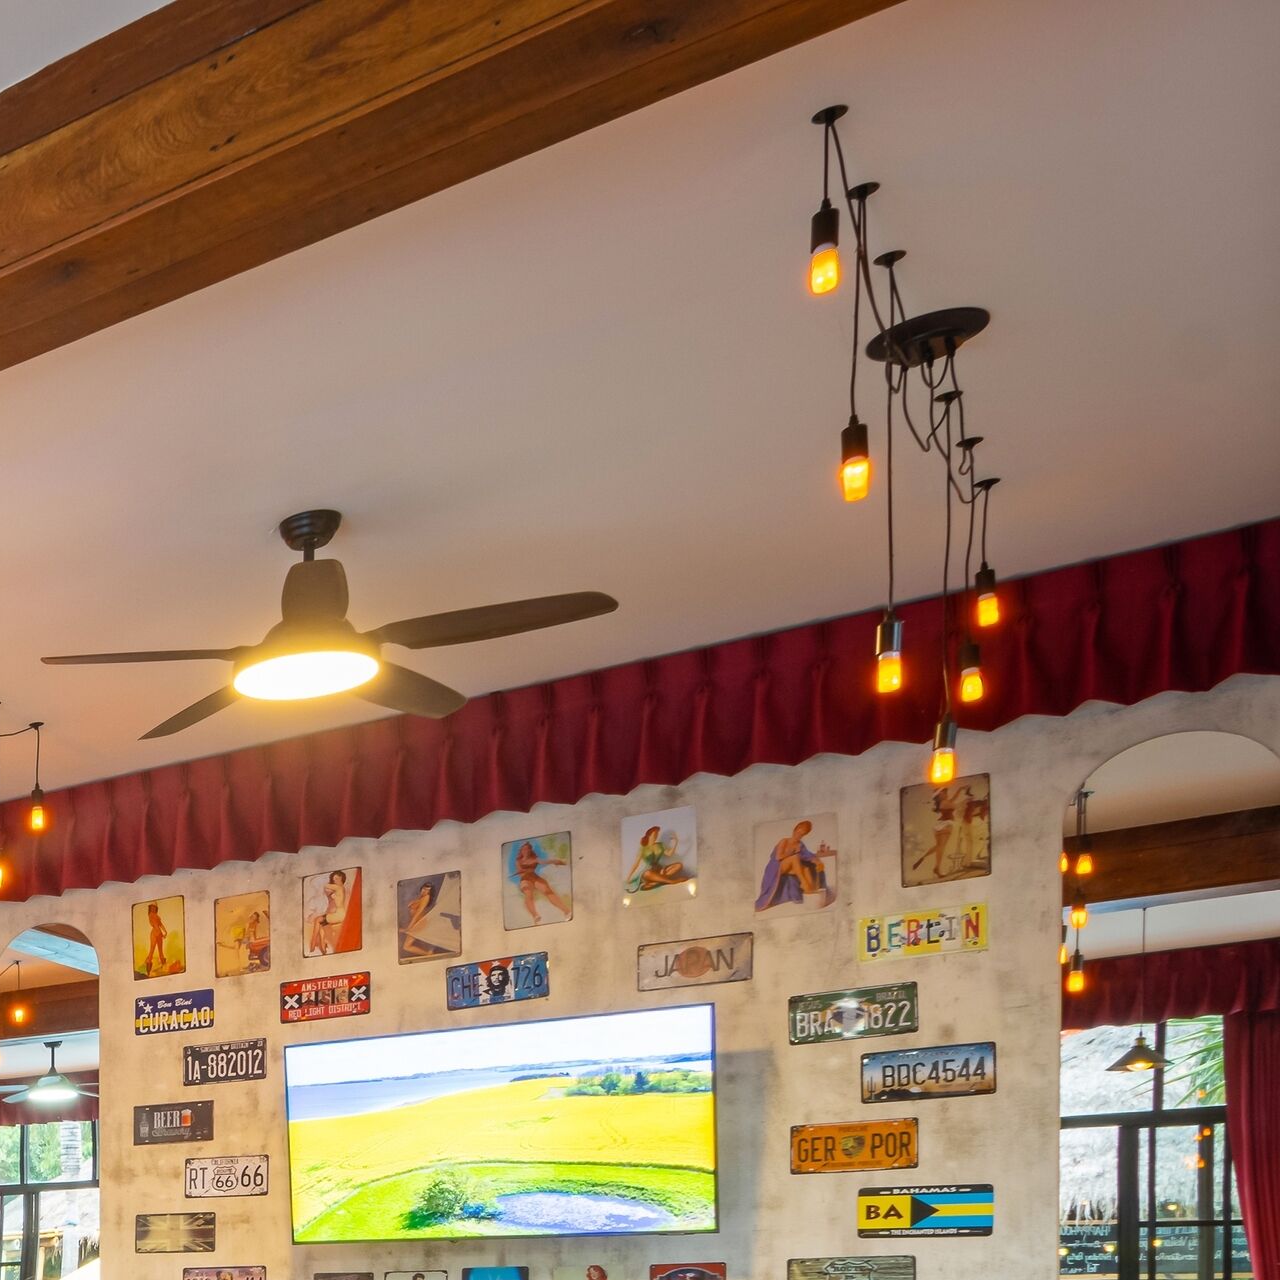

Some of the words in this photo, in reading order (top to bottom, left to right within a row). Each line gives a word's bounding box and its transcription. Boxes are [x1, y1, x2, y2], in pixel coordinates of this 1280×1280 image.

[866, 912, 980, 952] BERLIN
[655, 947, 734, 978] JAPAN
[301, 978, 349, 992] AMSTERDAM
[450, 971, 482, 1000] CHE
[511, 963, 542, 992] 726
[157, 1000, 172, 1009] Bon
[288, 1009, 302, 1019] RED
[305, 1006, 325, 1017] LIGHT
[328, 1002, 361, 1014] DISTRICT
[796, 1010, 833, 1038] BRA
[186, 1049, 263, 1080] 1A-882012
[153, 1110, 180, 1129] BEER
[797, 1136, 836, 1163] GER
[870, 1131, 911, 1160] POR
[189, 1167, 208, 1190] RT
[240, 1164, 264, 1187] 66
[215, 1175, 233, 1188] 66
[892, 1186, 958, 1195] BAHAMAS
[865, 1204, 904, 1221] BA
